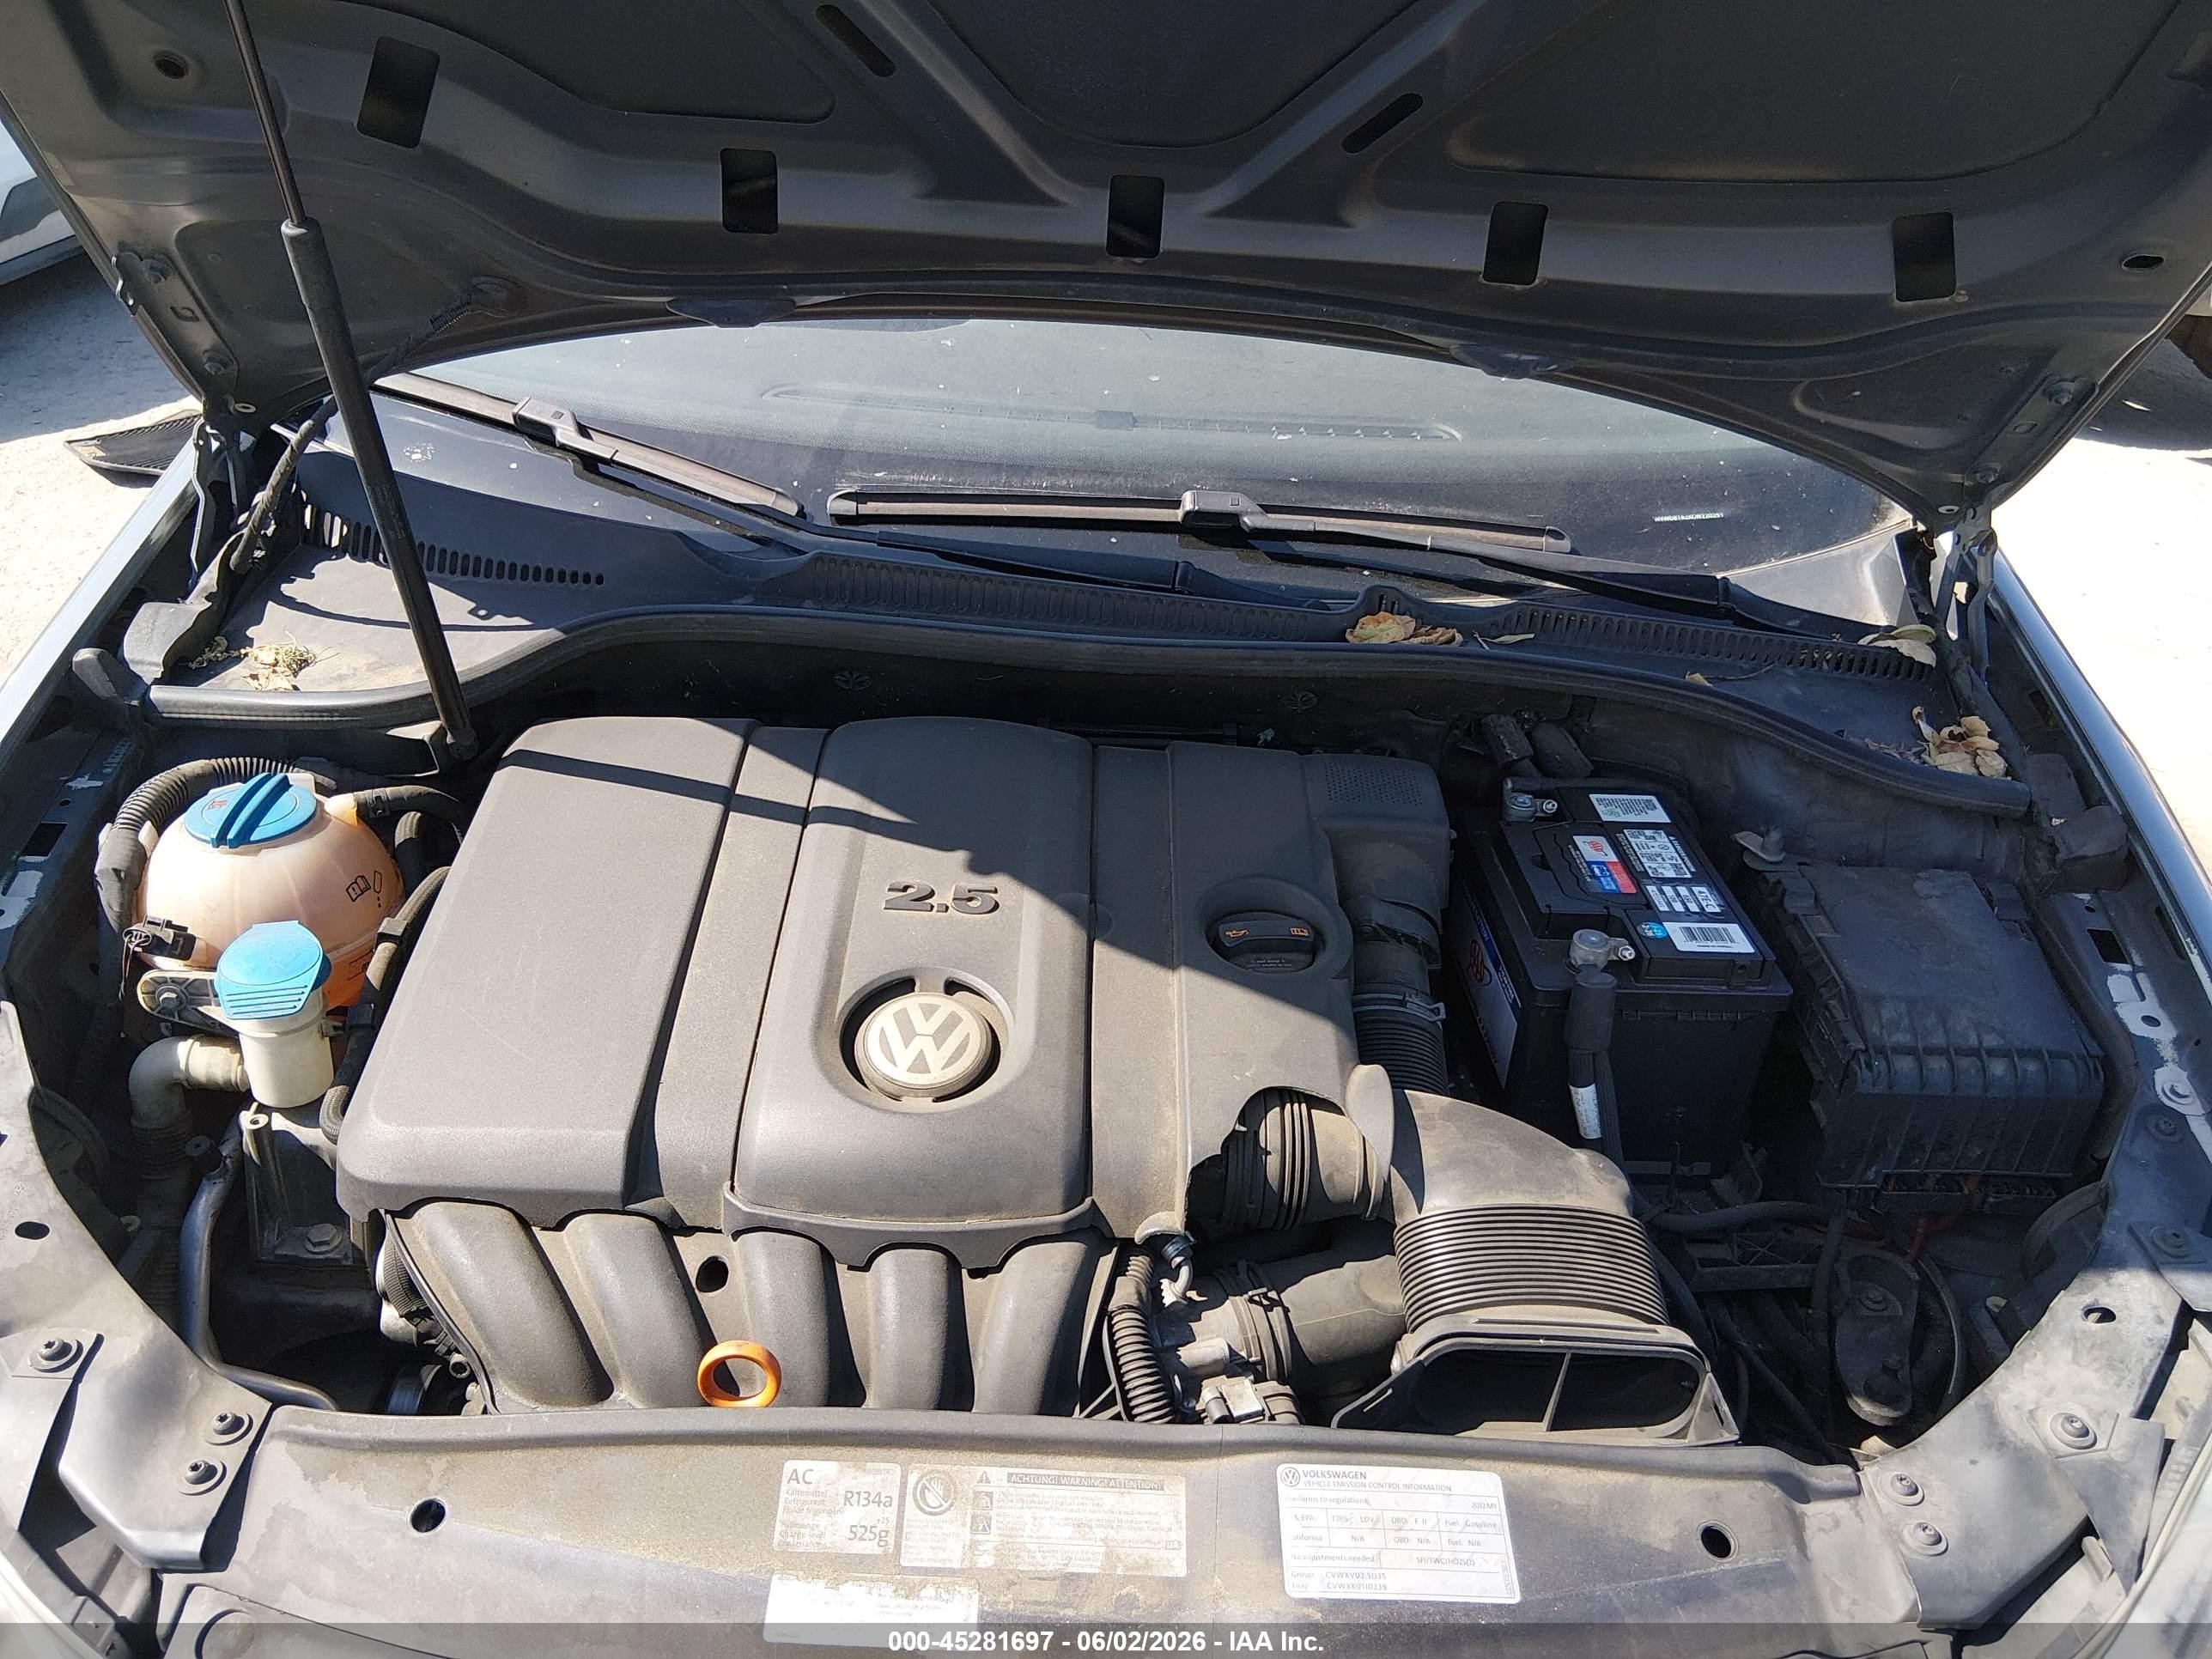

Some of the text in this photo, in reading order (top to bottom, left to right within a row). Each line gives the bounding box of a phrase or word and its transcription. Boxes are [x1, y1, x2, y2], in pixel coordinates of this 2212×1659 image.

[883, 880, 1000, 915] 2.5
[787, 1468, 814, 1485] AC
[1303, 1469, 1367, 1480] VOLKSWAGEN
[1332, 1480, 1367, 1490] EMISSION
[1368, 1482, 1401, 1491] CONTROL
[1401, 1483, 1452, 1492] INFORMATION
[843, 1490, 894, 1508] R134a
[848, 1524, 890, 1547] 525g
[1351, 1534, 1365, 1543] N/A
[1417, 1536, 1431, 1546] N/A
[1467, 1539, 1482, 1547] N/A
